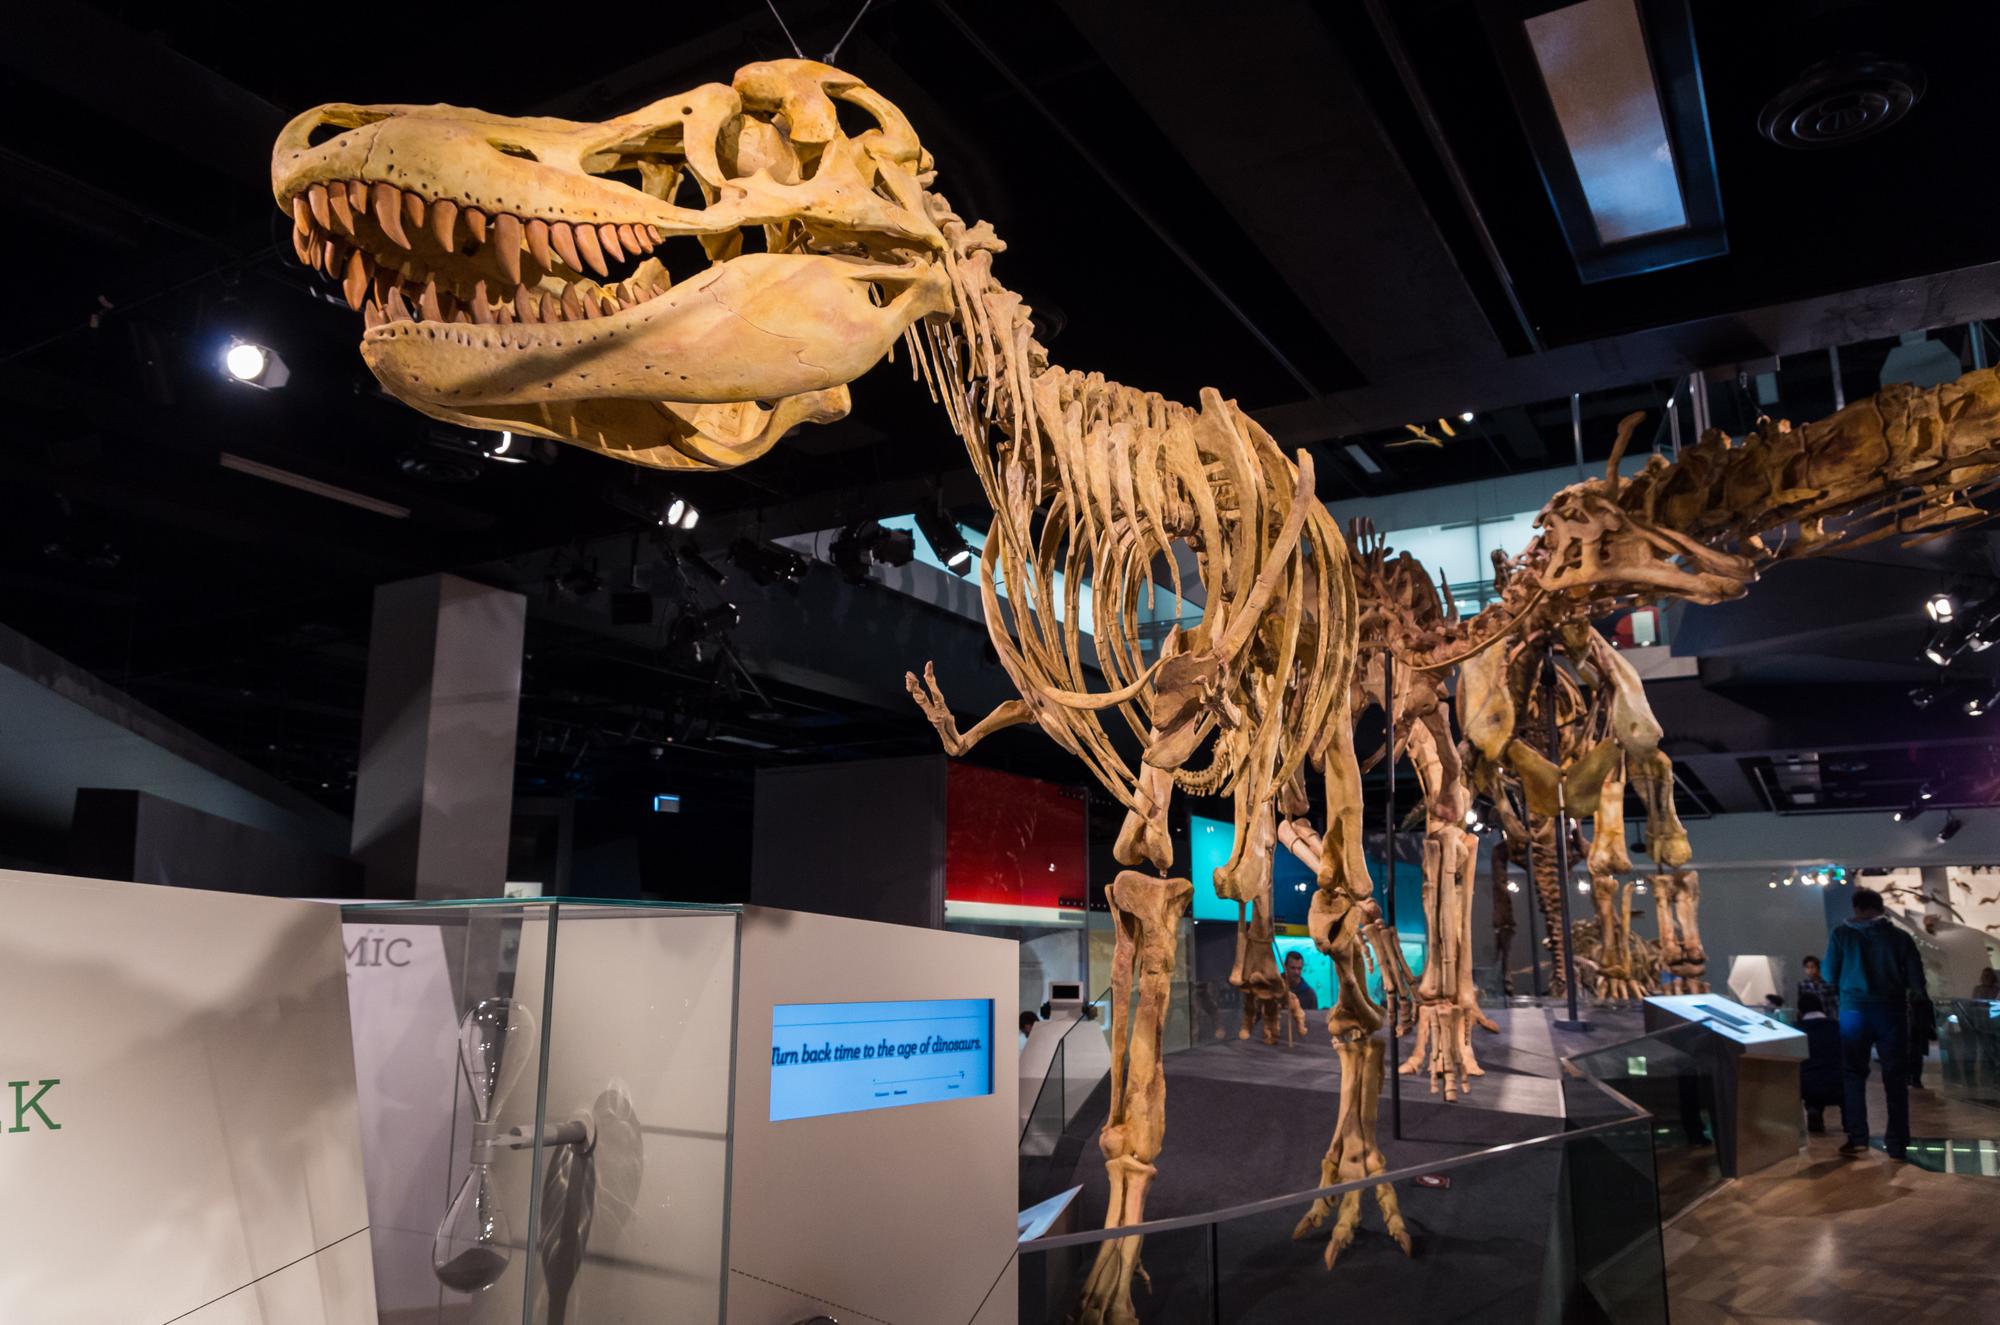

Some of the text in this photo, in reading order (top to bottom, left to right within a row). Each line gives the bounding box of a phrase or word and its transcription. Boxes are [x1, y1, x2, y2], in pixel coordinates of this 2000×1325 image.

[771, 1035, 982, 1065] Turn back time to the age of dinosaurs.
[0, 1079, 62, 1134] K
